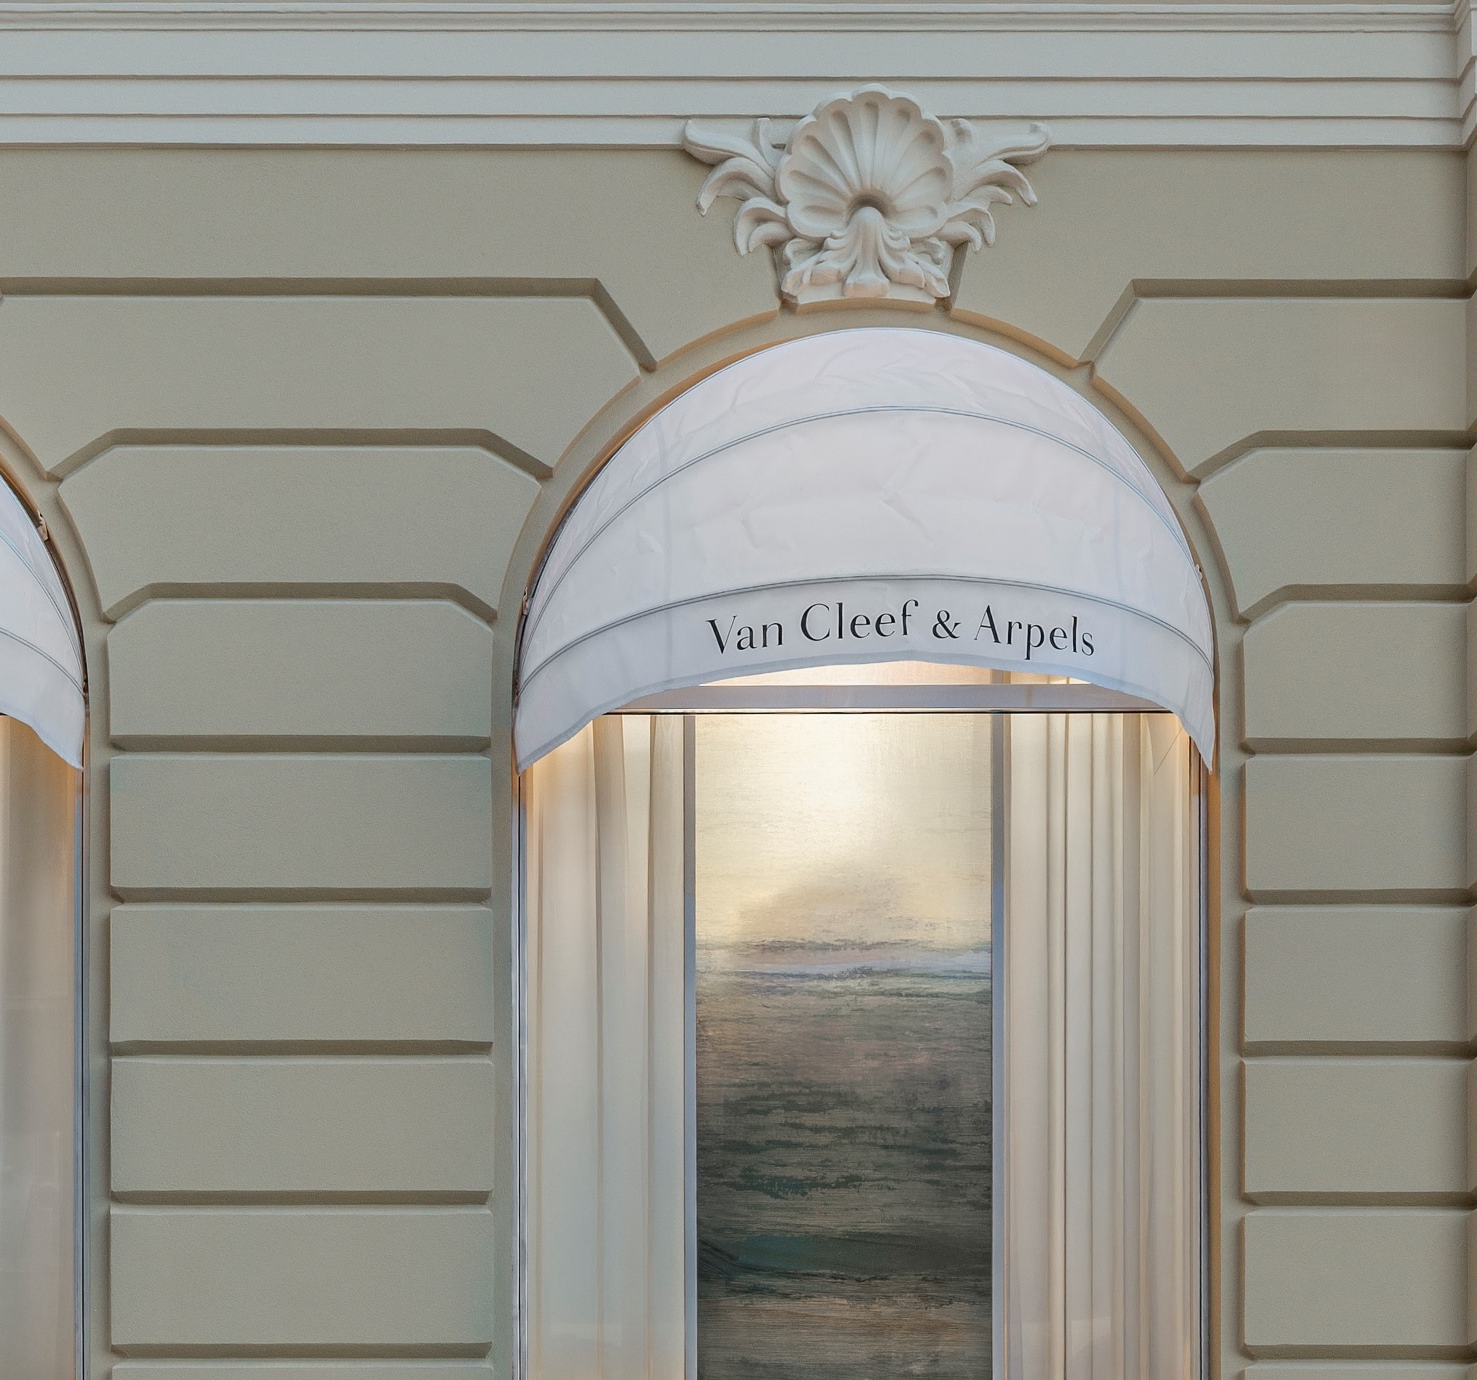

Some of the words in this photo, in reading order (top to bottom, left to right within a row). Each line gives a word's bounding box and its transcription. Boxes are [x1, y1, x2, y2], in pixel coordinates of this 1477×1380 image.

[706, 615, 784, 655] Van
[800, 599, 919, 642] Cleef
[932, 609, 961, 639] &
[973, 604, 1095, 661] Arpels
